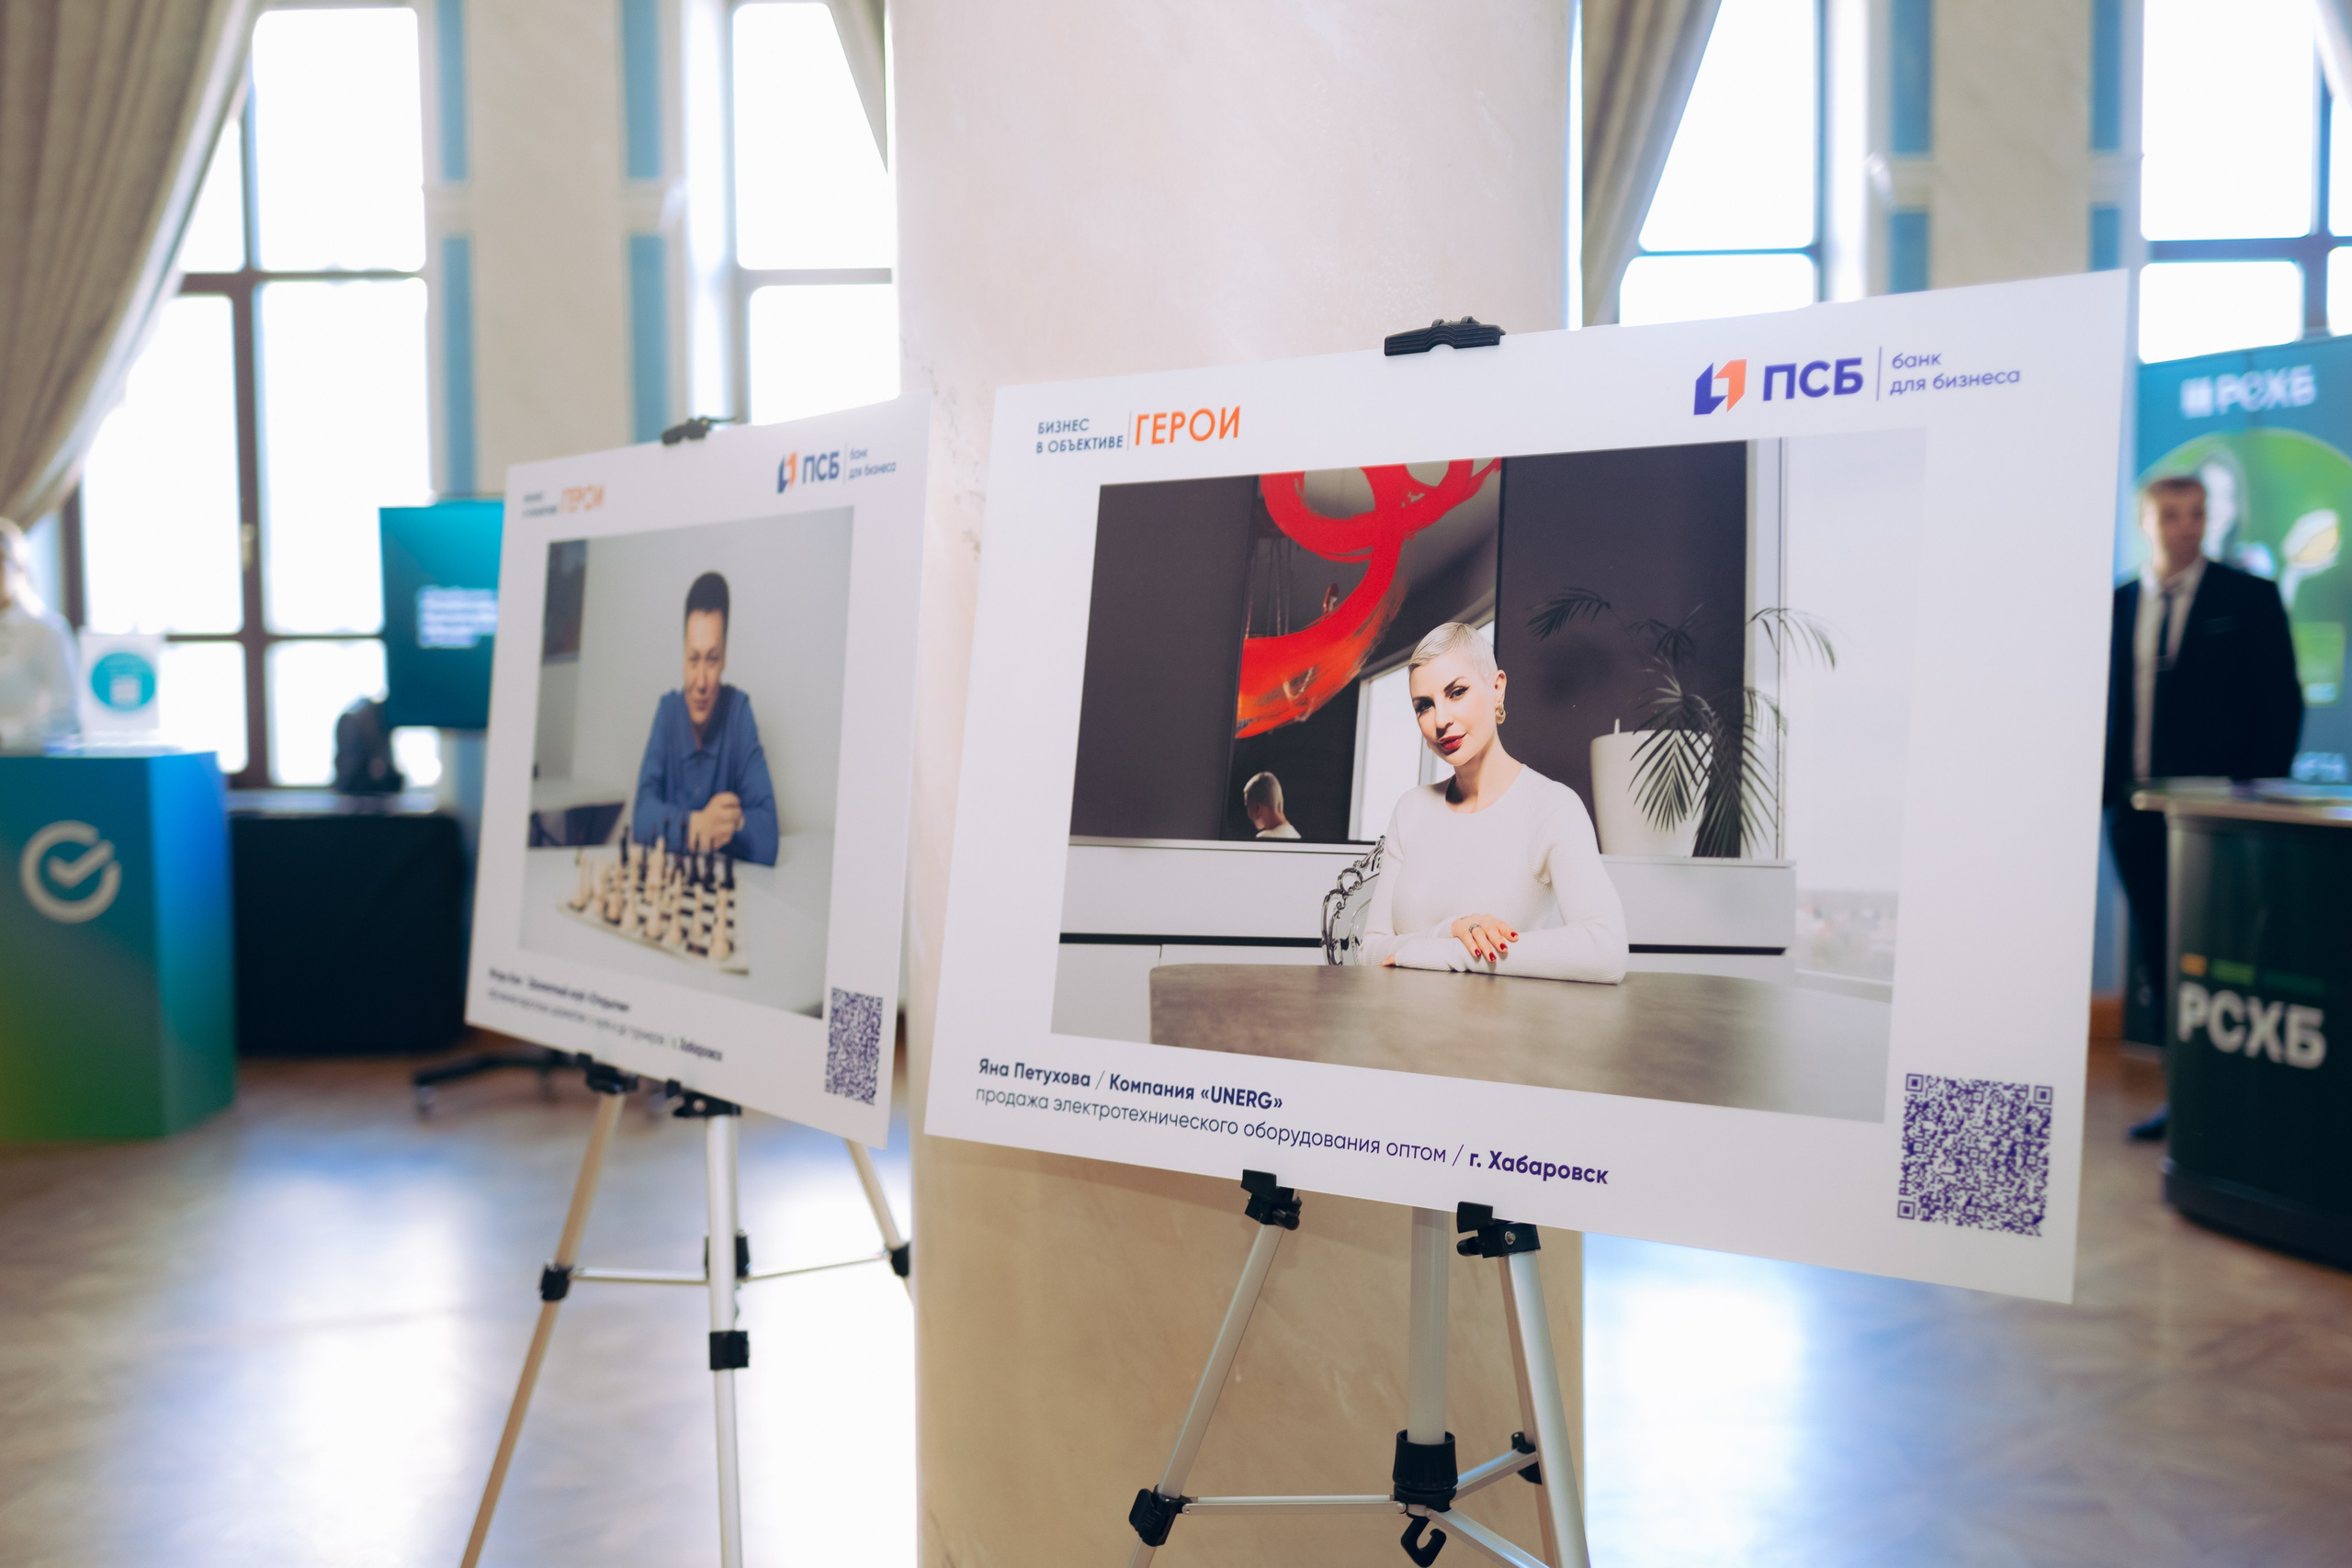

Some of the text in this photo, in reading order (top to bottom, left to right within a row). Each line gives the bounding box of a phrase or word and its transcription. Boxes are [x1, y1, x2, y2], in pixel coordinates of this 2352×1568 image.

[1762, 356, 1864, 401] ПСБ
[1892, 353, 1943, 370] банк
[1889, 369, 2021, 396] для бизнеса
[1037, 418, 1090, 434] БИЗНЕС
[1135, 405, 1240, 446] ГЕРОИ
[1035, 435, 1124, 454] В ОБЪЕКТИВЕ
[802, 450, 840, 484] ПСБ
[2177, 980, 2326, 1069] РСХБ
[978, 1058, 1010, 1077] Яна
[1013, 1062, 1091, 1088] Петухова
[1109, 1073, 1194, 1100] Компания
[1200, 1085, 1283, 1110] «UNERG»
[976, 1087, 1049, 1111] продажа
[1052, 1098, 1238, 1135] электротехнического
[1243, 1122, 1381, 1155] оборудования
[1385, 1141, 1447, 1164] оптом
[1469, 1150, 1483, 1168] г.
[1487, 1149, 1610, 1185] Хабаровск
